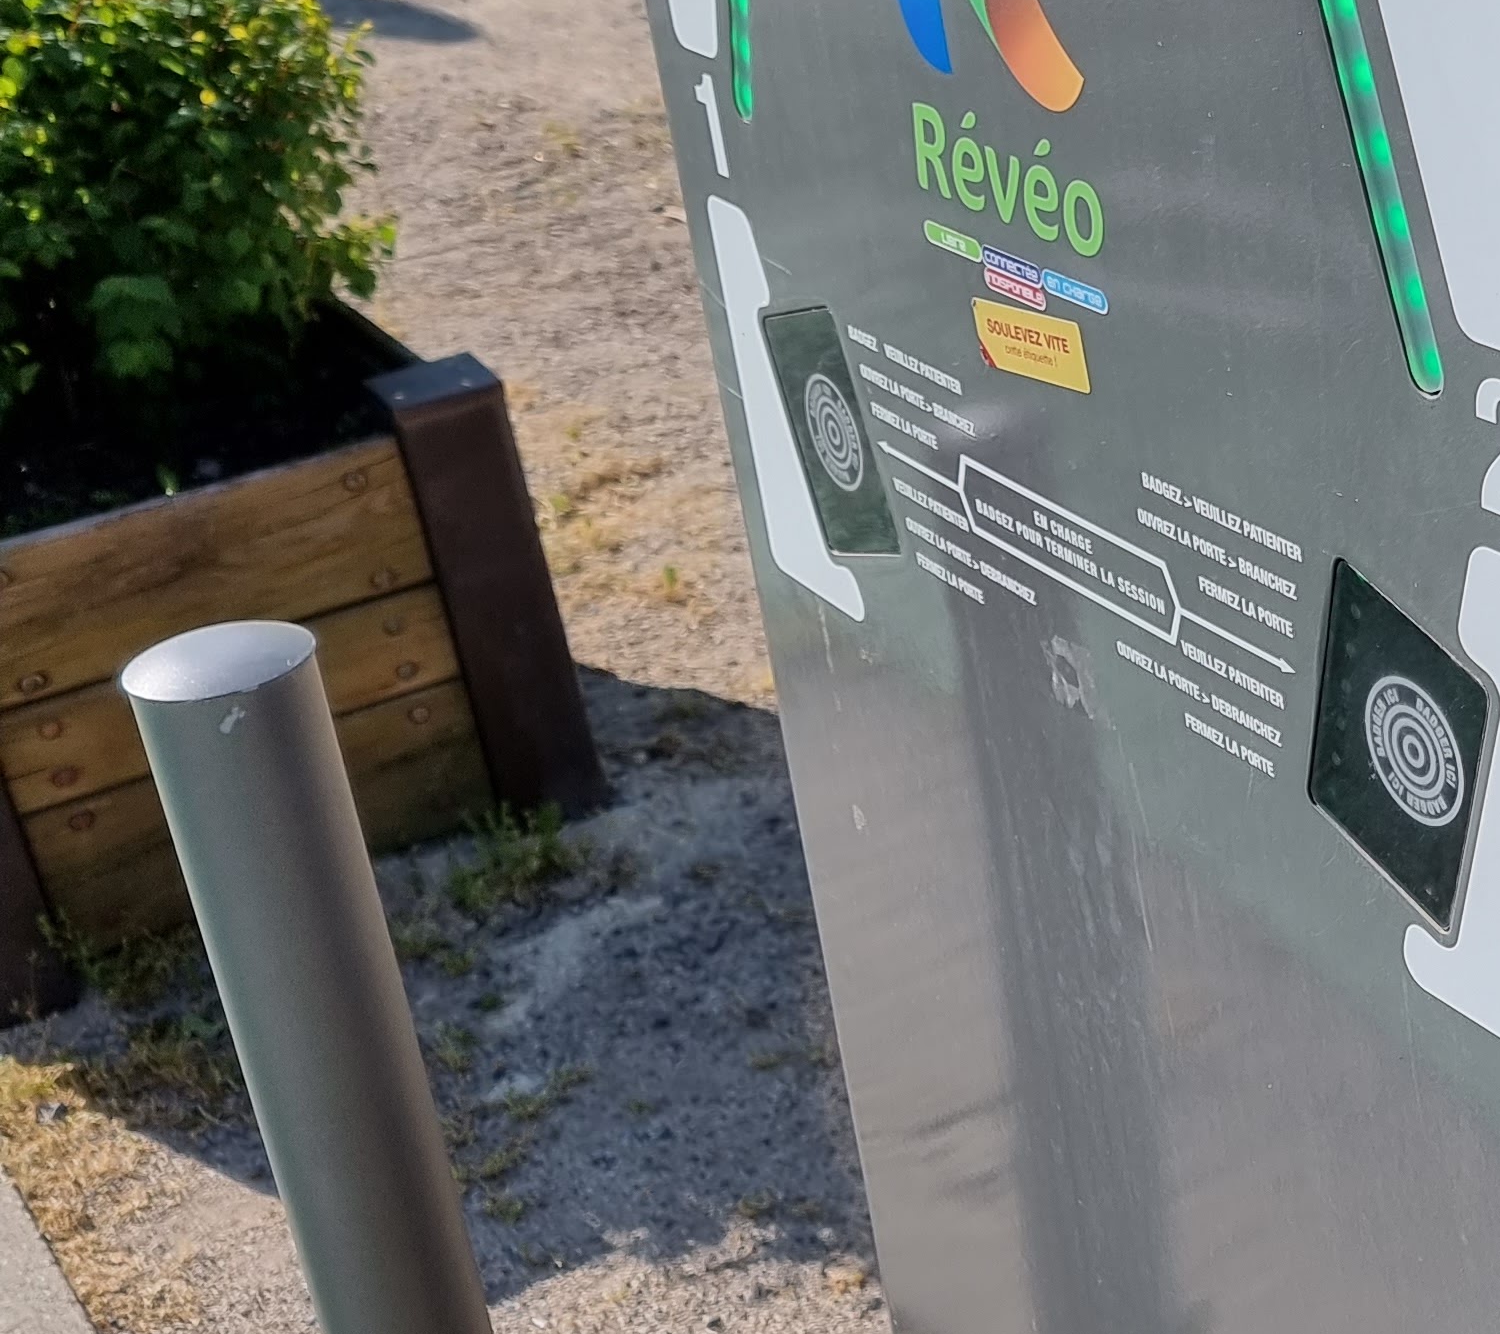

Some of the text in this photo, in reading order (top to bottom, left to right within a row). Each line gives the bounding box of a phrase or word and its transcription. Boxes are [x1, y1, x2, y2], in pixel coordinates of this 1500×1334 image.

[695, 73, 730, 179] 1
[911, 101, 1105, 258] Révéo
[986, 318, 1070, 354] SOULEVEZ VITE
[888, 379, 901, 397] LA
[900, 418, 913, 436] LA
[935, 534, 947, 552] LA
[1033, 510, 1093, 555] EN CHARGE
[1141, 471, 1183, 506] BADGEZ
[1192, 496, 1243, 535] VEUILLEZ
[1243, 520, 1303, 563] PATIENTER
[946, 570, 959, 589] LA
[975, 498, 1166, 616] BADGEZ POUR TERMINER LA SESSION
[1137, 508, 1177, 541] OUVREZ
[1177, 527, 1192, 549] LA
[1192, 534, 1228, 566] PORTE
[1237, 556, 1298, 601] BRANCHEZ
[1198, 576, 1294, 639] FERMEZ LA PORTE
[1116, 640, 1153, 674] OUVREZ
[1153, 661, 1168, 683] LA
[1168, 669, 1201, 701] PORTE
[1211, 693, 1283, 748] DEBRANCHEZ
[1180, 639, 1285, 710] VEUILLEZ PATIENTER
[1184, 712, 1276, 778] FERMEZ LA PORTE
[1372, 687, 1400, 758] BADGER ICI
[1415, 697, 1457, 789] BADGER ICI
